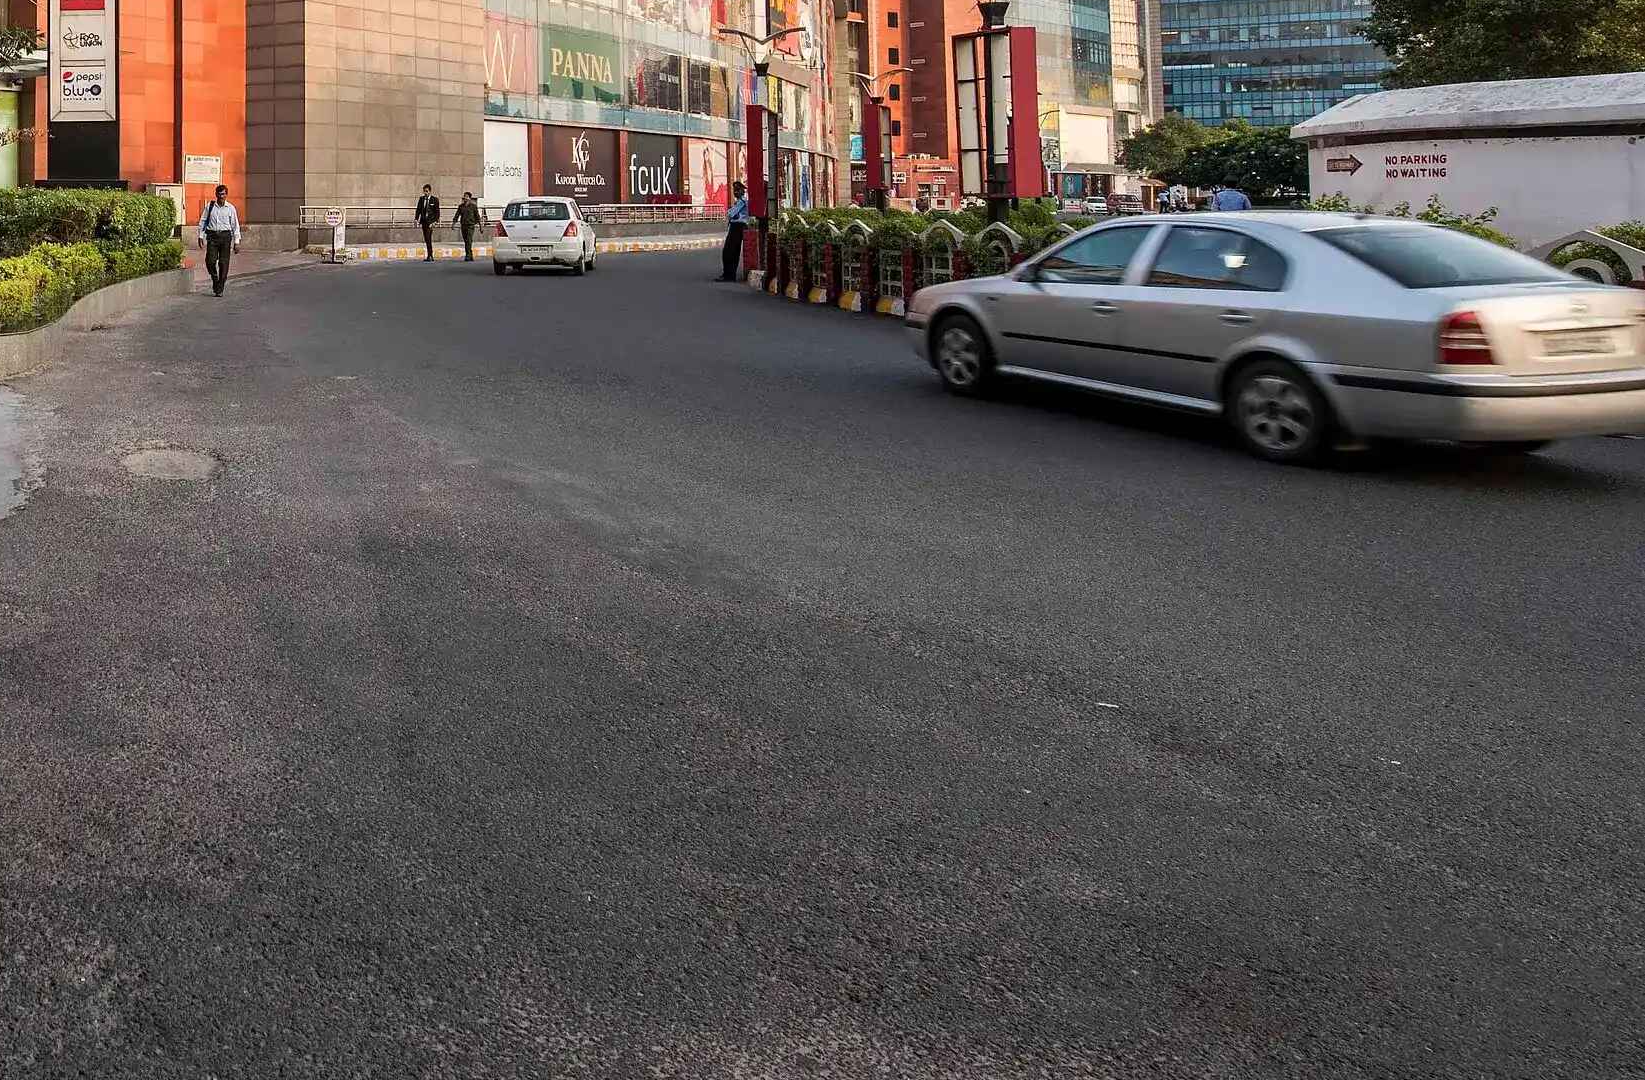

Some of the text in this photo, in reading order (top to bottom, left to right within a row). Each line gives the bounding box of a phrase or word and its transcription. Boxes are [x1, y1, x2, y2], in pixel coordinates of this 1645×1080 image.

[80, 32, 100, 41] FOOD
[551, 47, 614, 84] PANNA
[76, 72, 102, 82] pepsi
[1385, 154, 1447, 165] NO PARKING
[1385, 168, 1447, 178] NO WAITING
[555, 173, 576, 185] KAPOOR
[577, 173, 595, 185] WATCH
